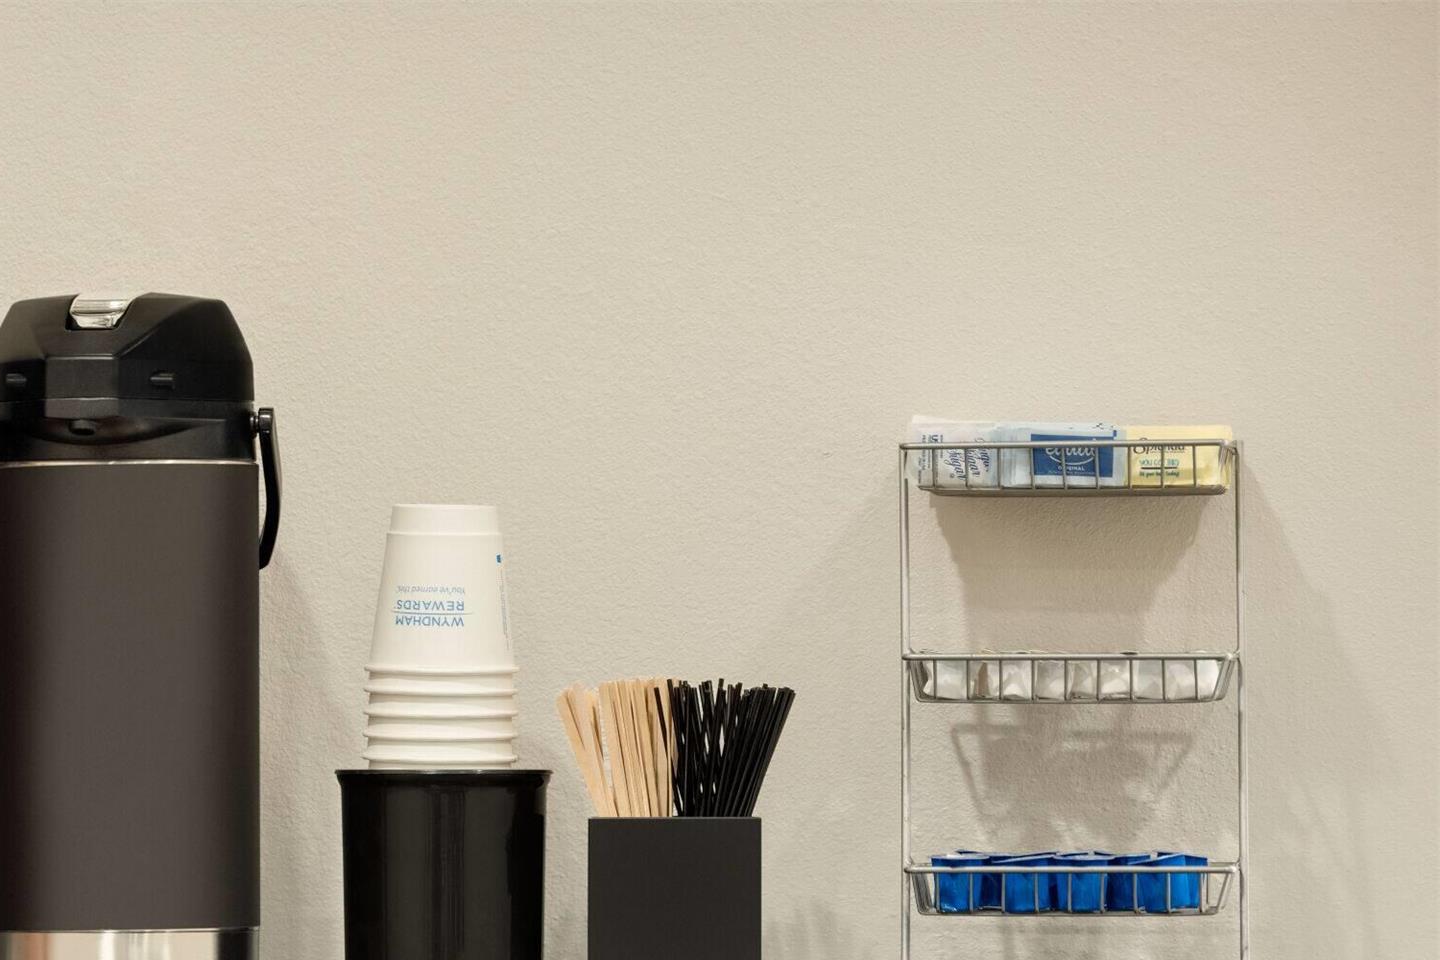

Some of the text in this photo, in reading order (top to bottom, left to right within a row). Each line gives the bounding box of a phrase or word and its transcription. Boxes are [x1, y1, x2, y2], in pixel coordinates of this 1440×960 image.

[1045, 438, 1096, 456] eual
[411, 585, 438, 593] earned
[396, 600, 464, 611] REWARDS
[395, 615, 464, 627] WYNDHAM
